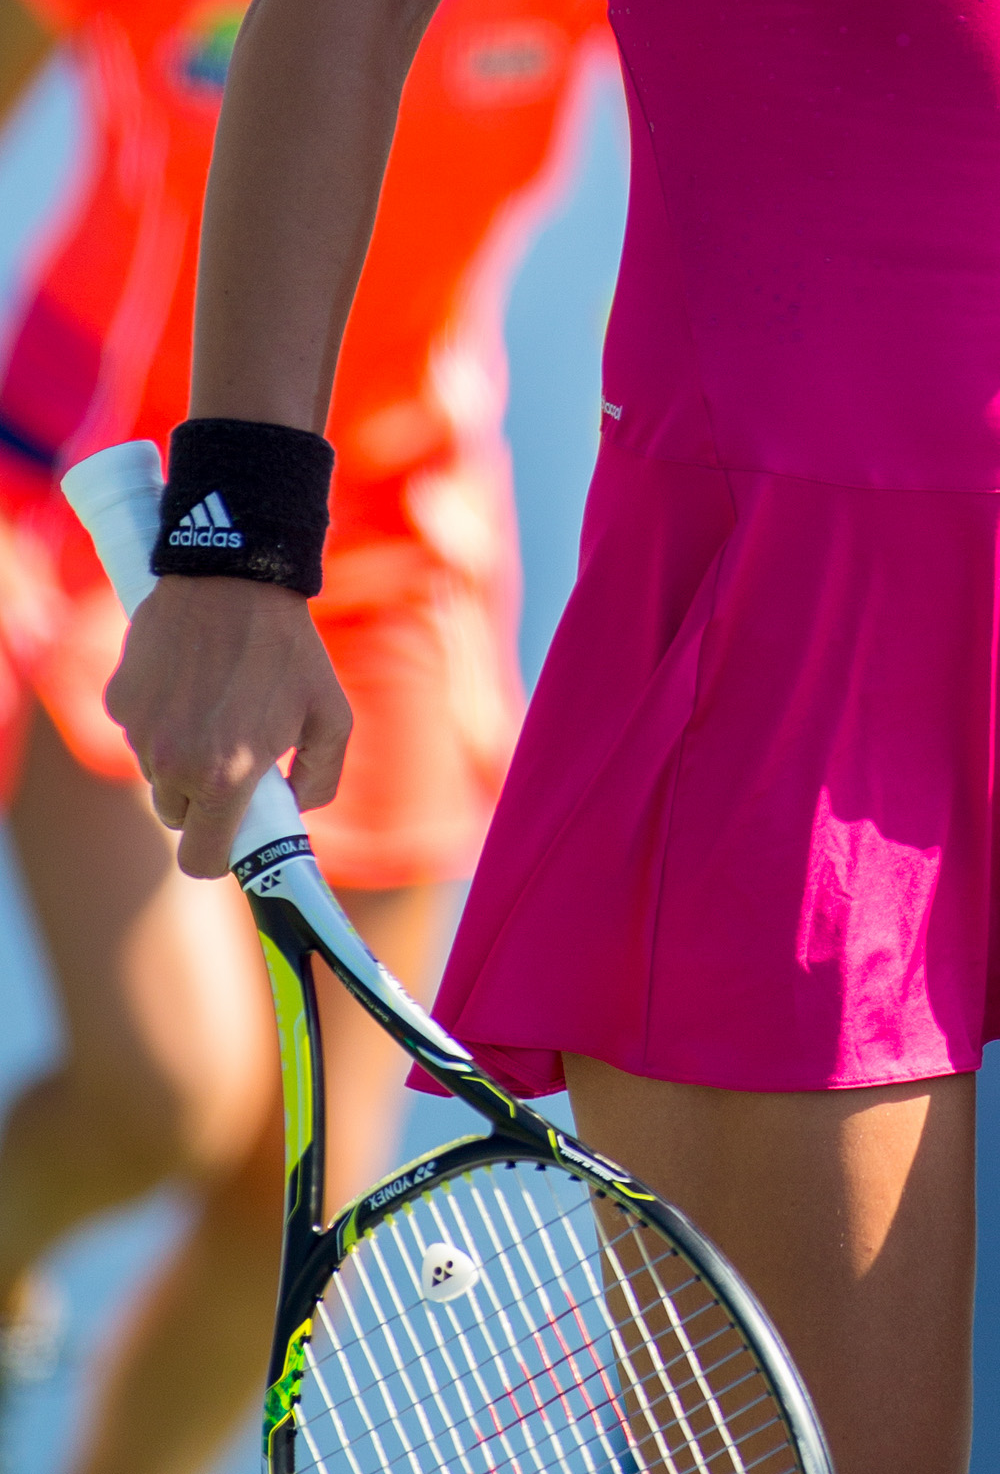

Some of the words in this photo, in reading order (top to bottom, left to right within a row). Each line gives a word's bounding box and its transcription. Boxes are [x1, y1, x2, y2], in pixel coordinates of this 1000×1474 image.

[168, 524, 242, 549] adidas
[257, 839, 298, 866] YONEX
[368, 1176, 413, 1212] YONEX
